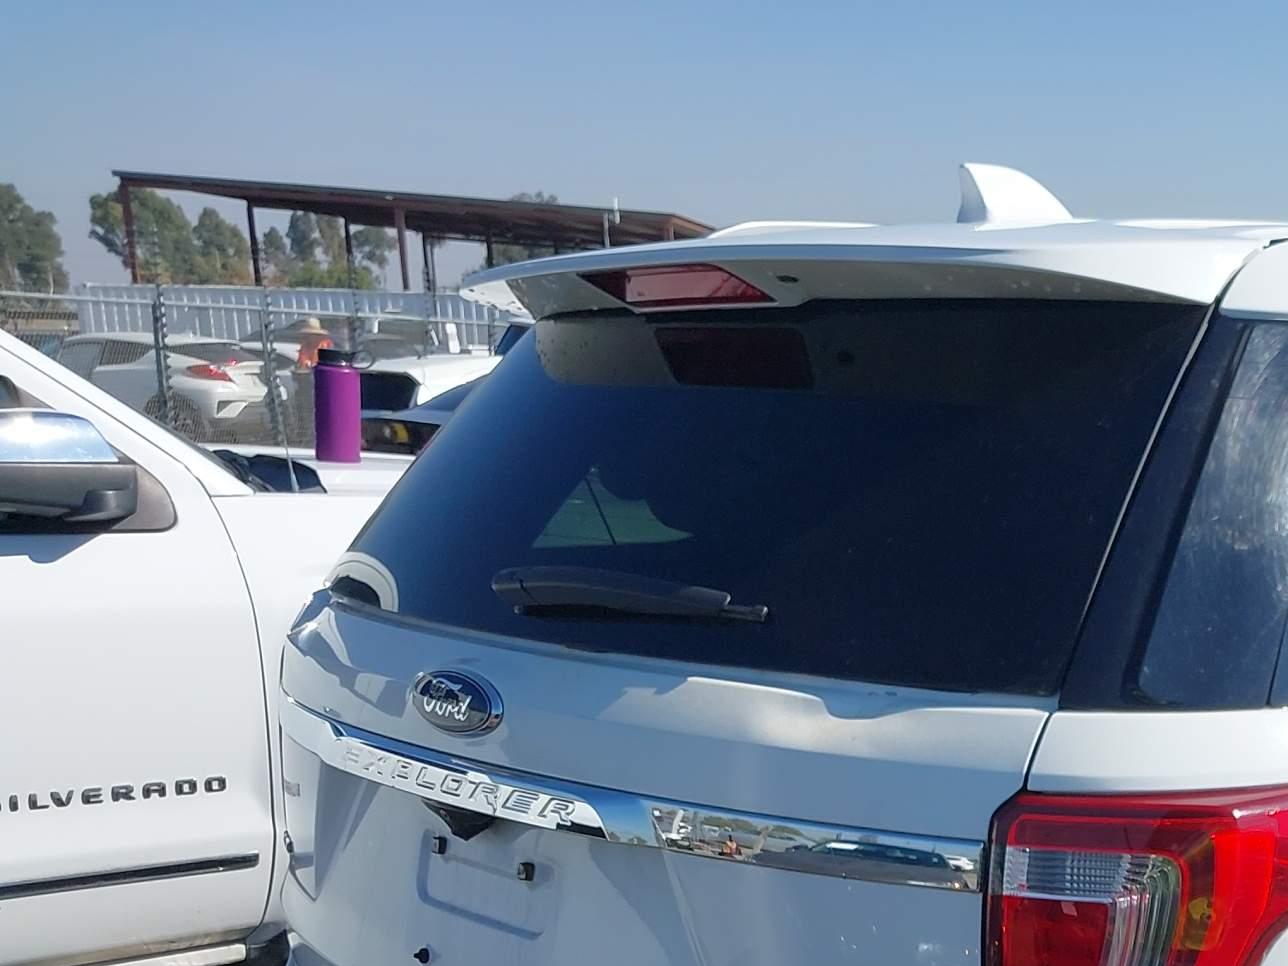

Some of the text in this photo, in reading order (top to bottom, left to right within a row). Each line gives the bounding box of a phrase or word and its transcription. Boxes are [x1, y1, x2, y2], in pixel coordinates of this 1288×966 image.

[423, 677, 473, 722] Ford
[0, 775, 227, 812] ILVERADO
[343, 748, 577, 827] EXPLORER
